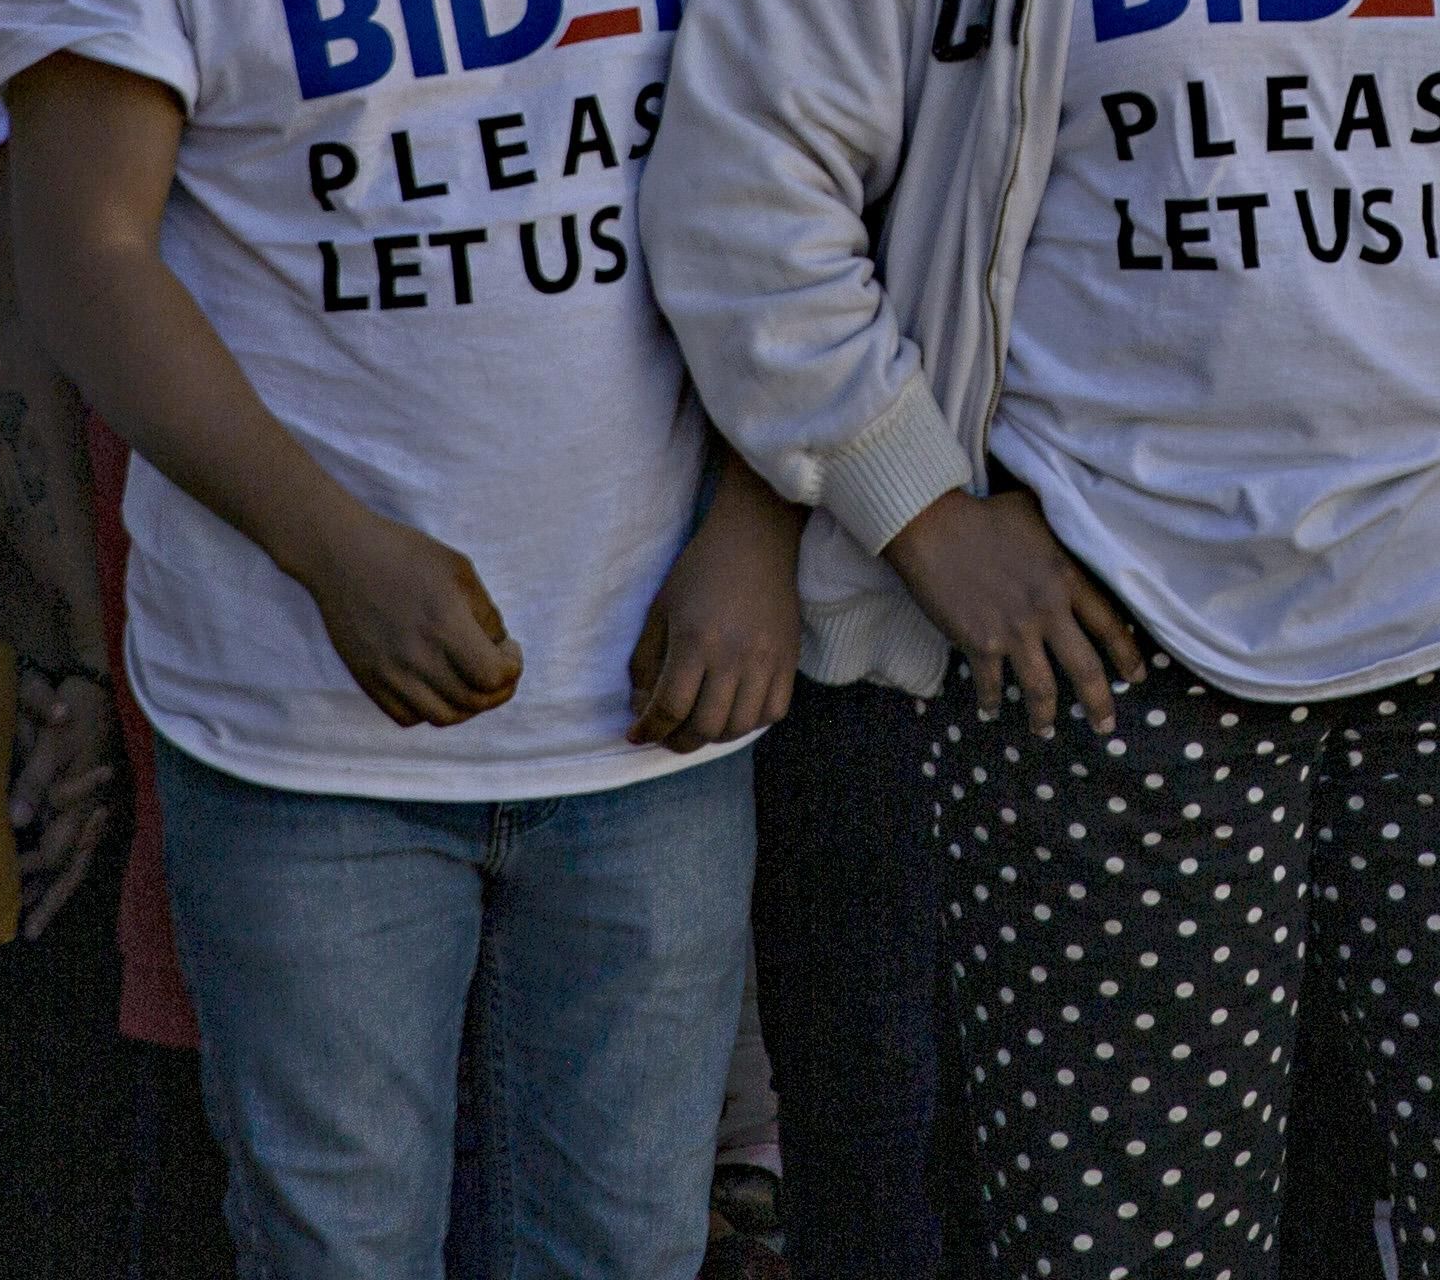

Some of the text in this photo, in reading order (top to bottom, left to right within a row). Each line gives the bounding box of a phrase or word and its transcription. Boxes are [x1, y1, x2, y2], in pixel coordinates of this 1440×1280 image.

[318, 205, 630, 313] LET US
[1114, 193, 1269, 271] LET
[1293, 187, 1405, 265] US
